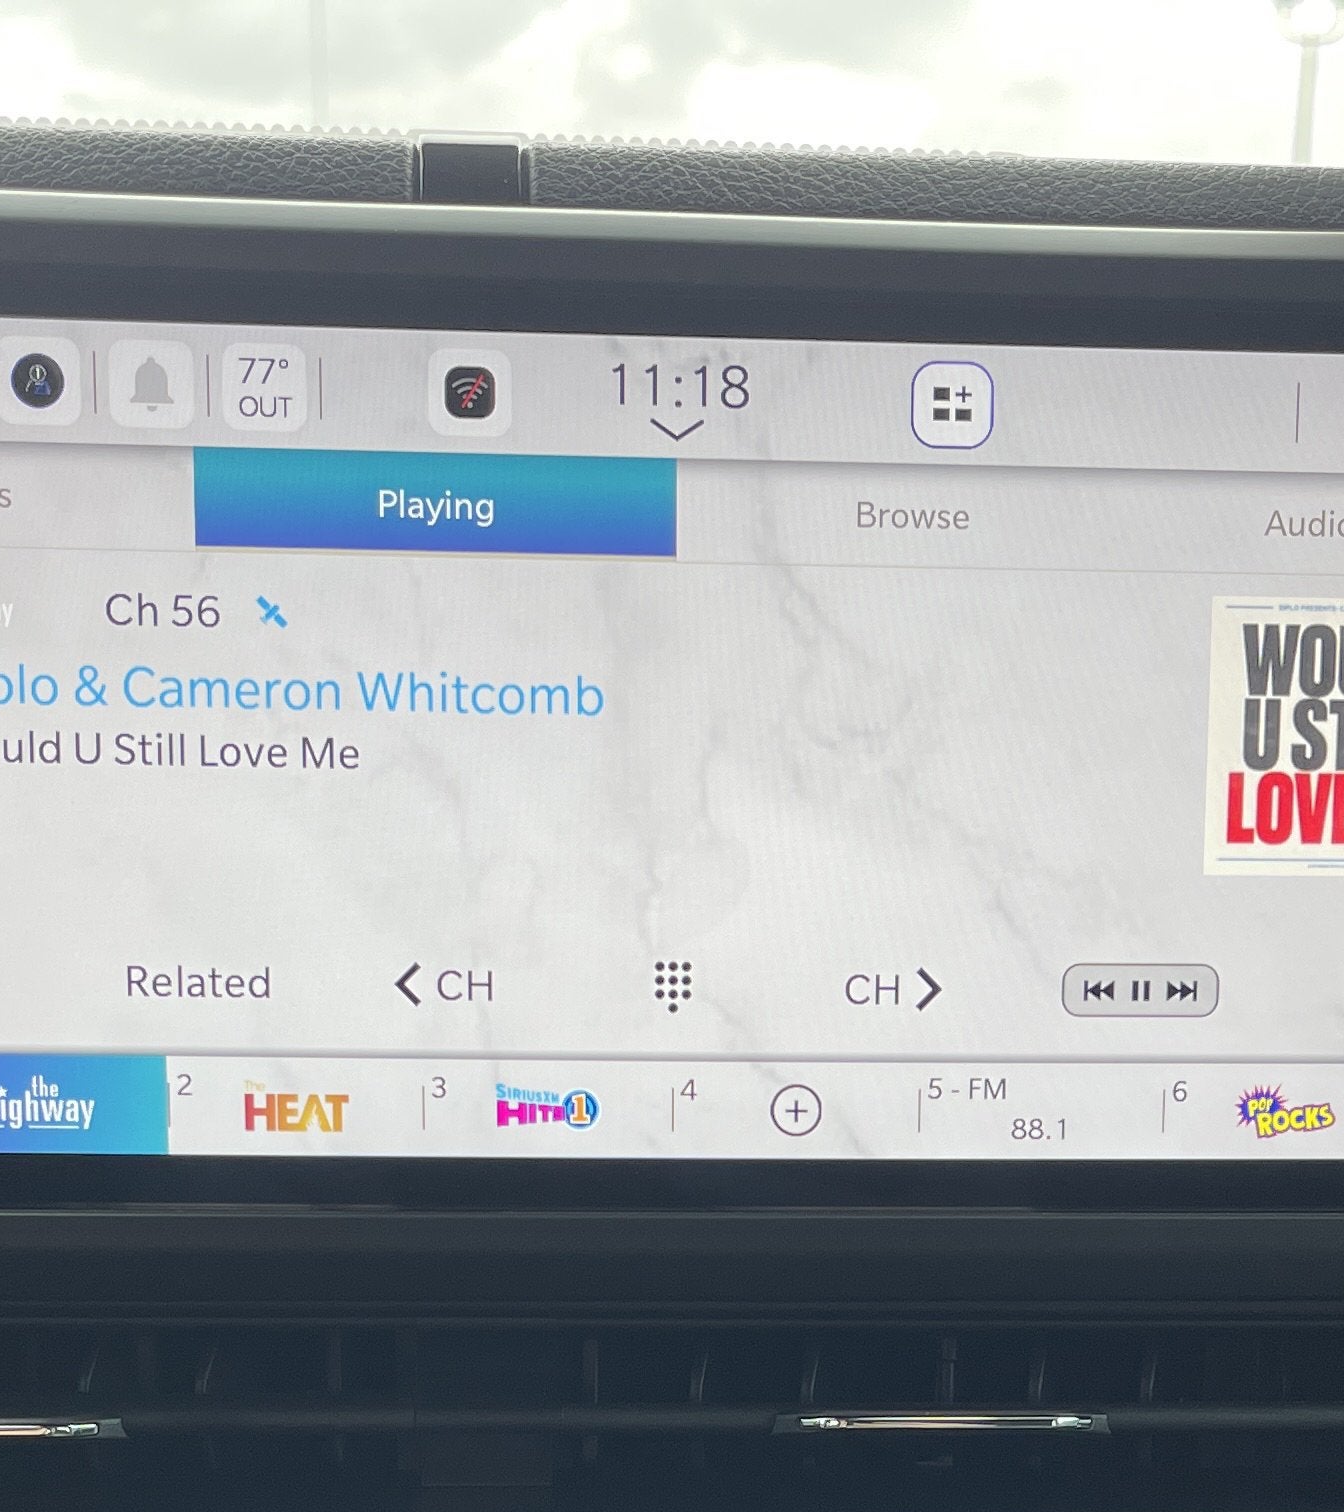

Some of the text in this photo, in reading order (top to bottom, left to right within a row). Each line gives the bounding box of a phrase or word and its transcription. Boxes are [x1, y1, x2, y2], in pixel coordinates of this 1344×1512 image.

[239, 357, 289, 384] 77°
[611, 363, 749, 409] 11:18
[239, 396, 292, 418] OUT
[378, 489, 495, 527] Playing
[856, 501, 970, 532] Browse
[106, 593, 220, 627] Ch 56
[75, 665, 107, 705] &
[123, 666, 340, 709] Cameron
[357, 671, 603, 716] Whitcomb
[1243, 700, 1283, 770] U
[75, 736, 101, 763] U
[114, 734, 186, 767] Still
[200, 735, 287, 767] Love
[302, 737, 359, 769] Me
[127, 966, 271, 998] Related
[436, 970, 494, 1002] CH
[846, 975, 899, 1007] CH
[32, 1076, 58, 1097] the
[177, 1074, 192, 1096] 2
[431, 1077, 447, 1099] 3
[681, 1079, 697, 1100] 4
[928, 1078, 942, 1100] 5
[969, 1078, 1007, 1100] FM
[1173, 1081, 1188, 1103] 6
[244, 1094, 349, 1132] HEAT
[570, 1094, 590, 1124] 1
[1257, 1104, 1335, 1136] ROCKS
[1011, 1119, 1068, 1140] 88.1
